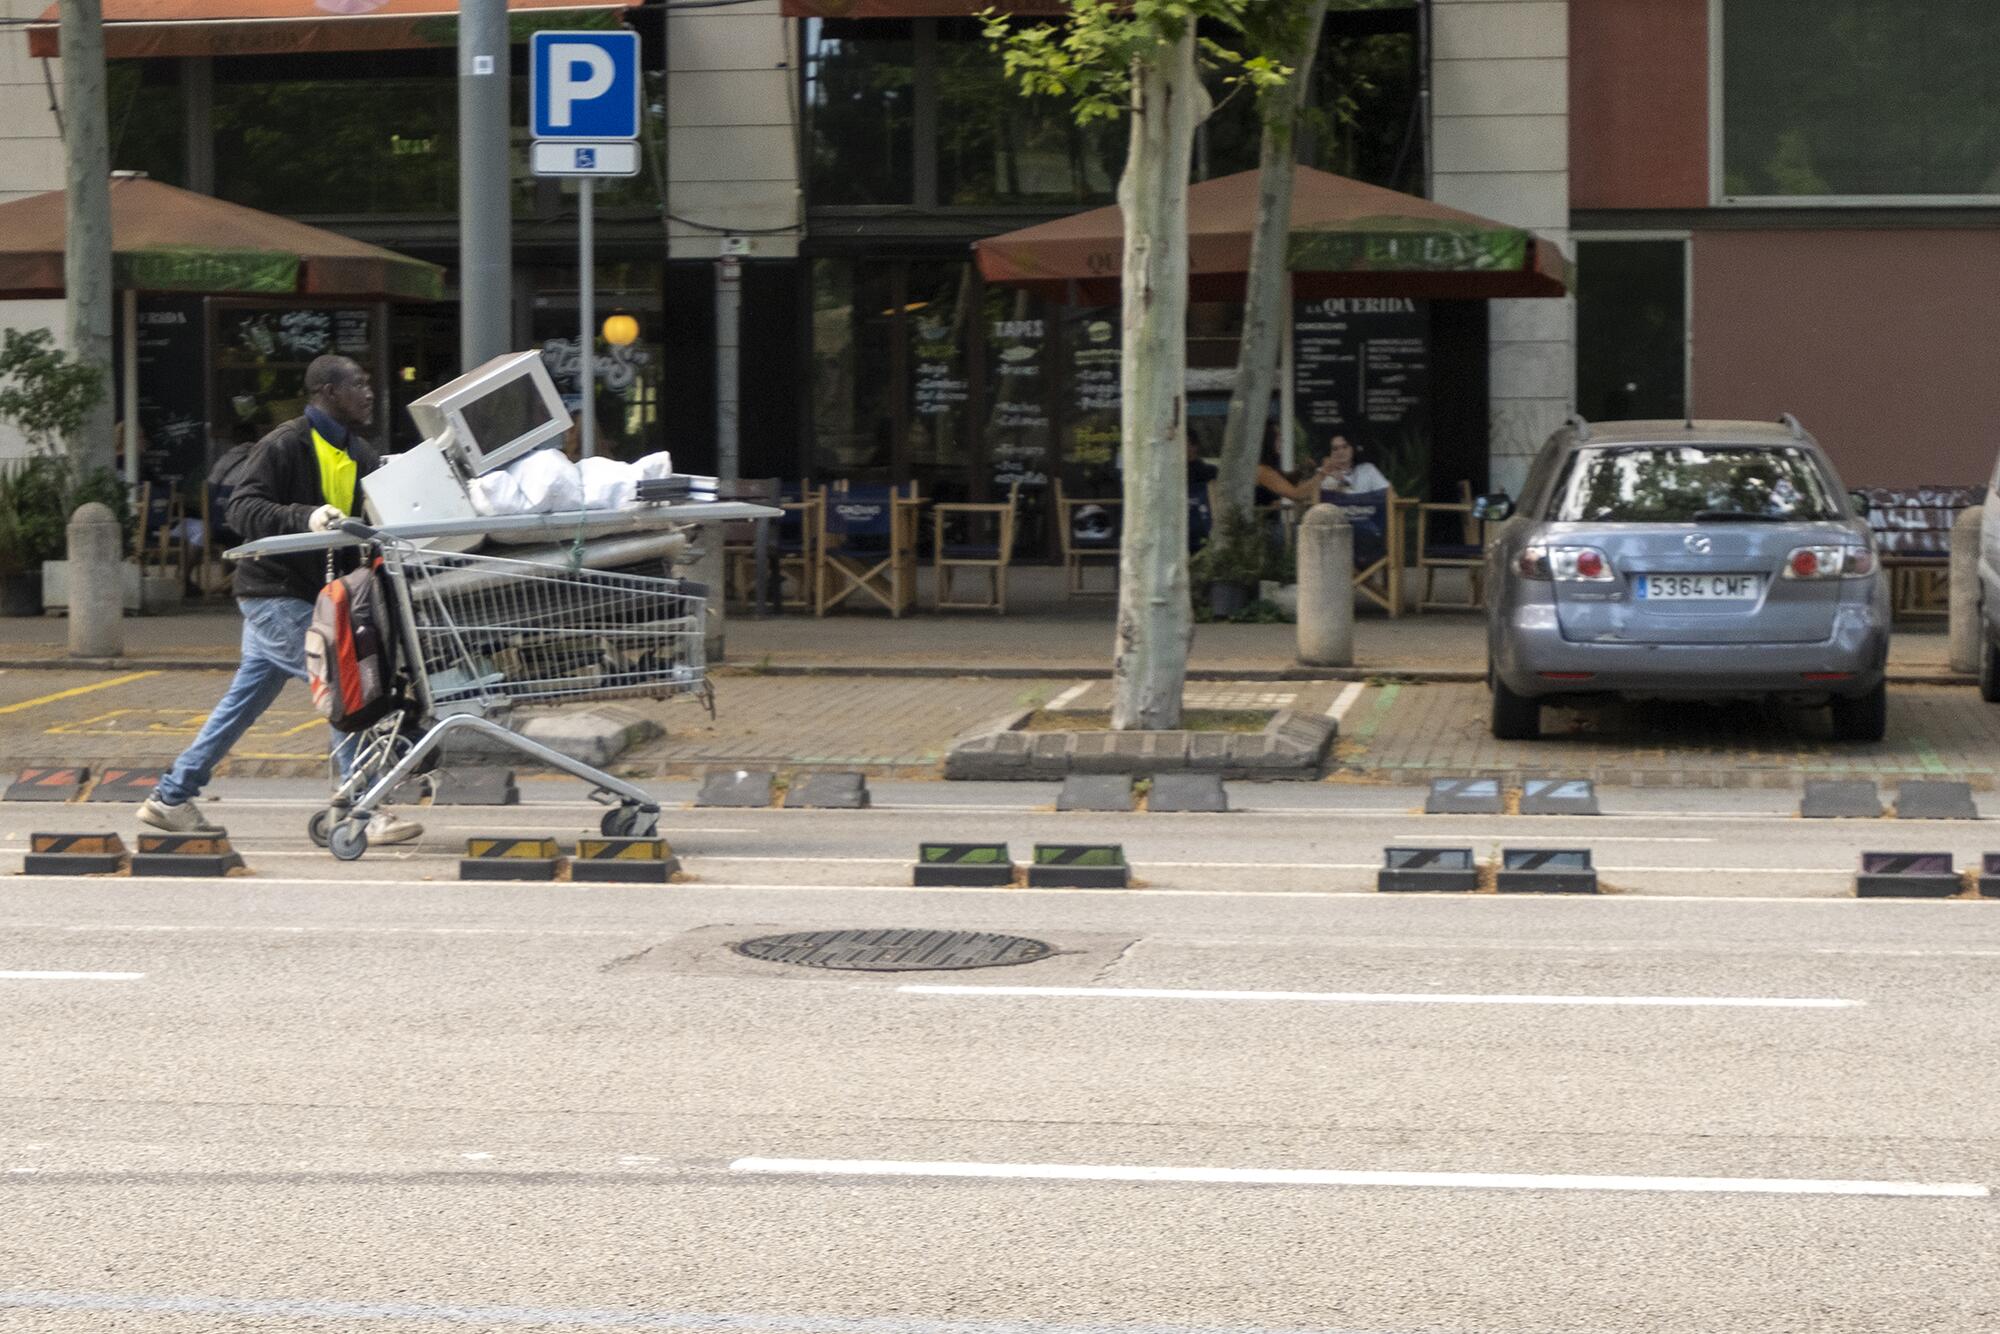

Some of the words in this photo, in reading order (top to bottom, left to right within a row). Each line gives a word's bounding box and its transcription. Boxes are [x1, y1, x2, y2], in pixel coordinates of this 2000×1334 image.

[548, 43, 616, 127] P
[1323, 297, 1416, 317] QUERIDA
[1652, 577, 1704, 597] 5364
[1712, 576, 1751, 596] CWF
